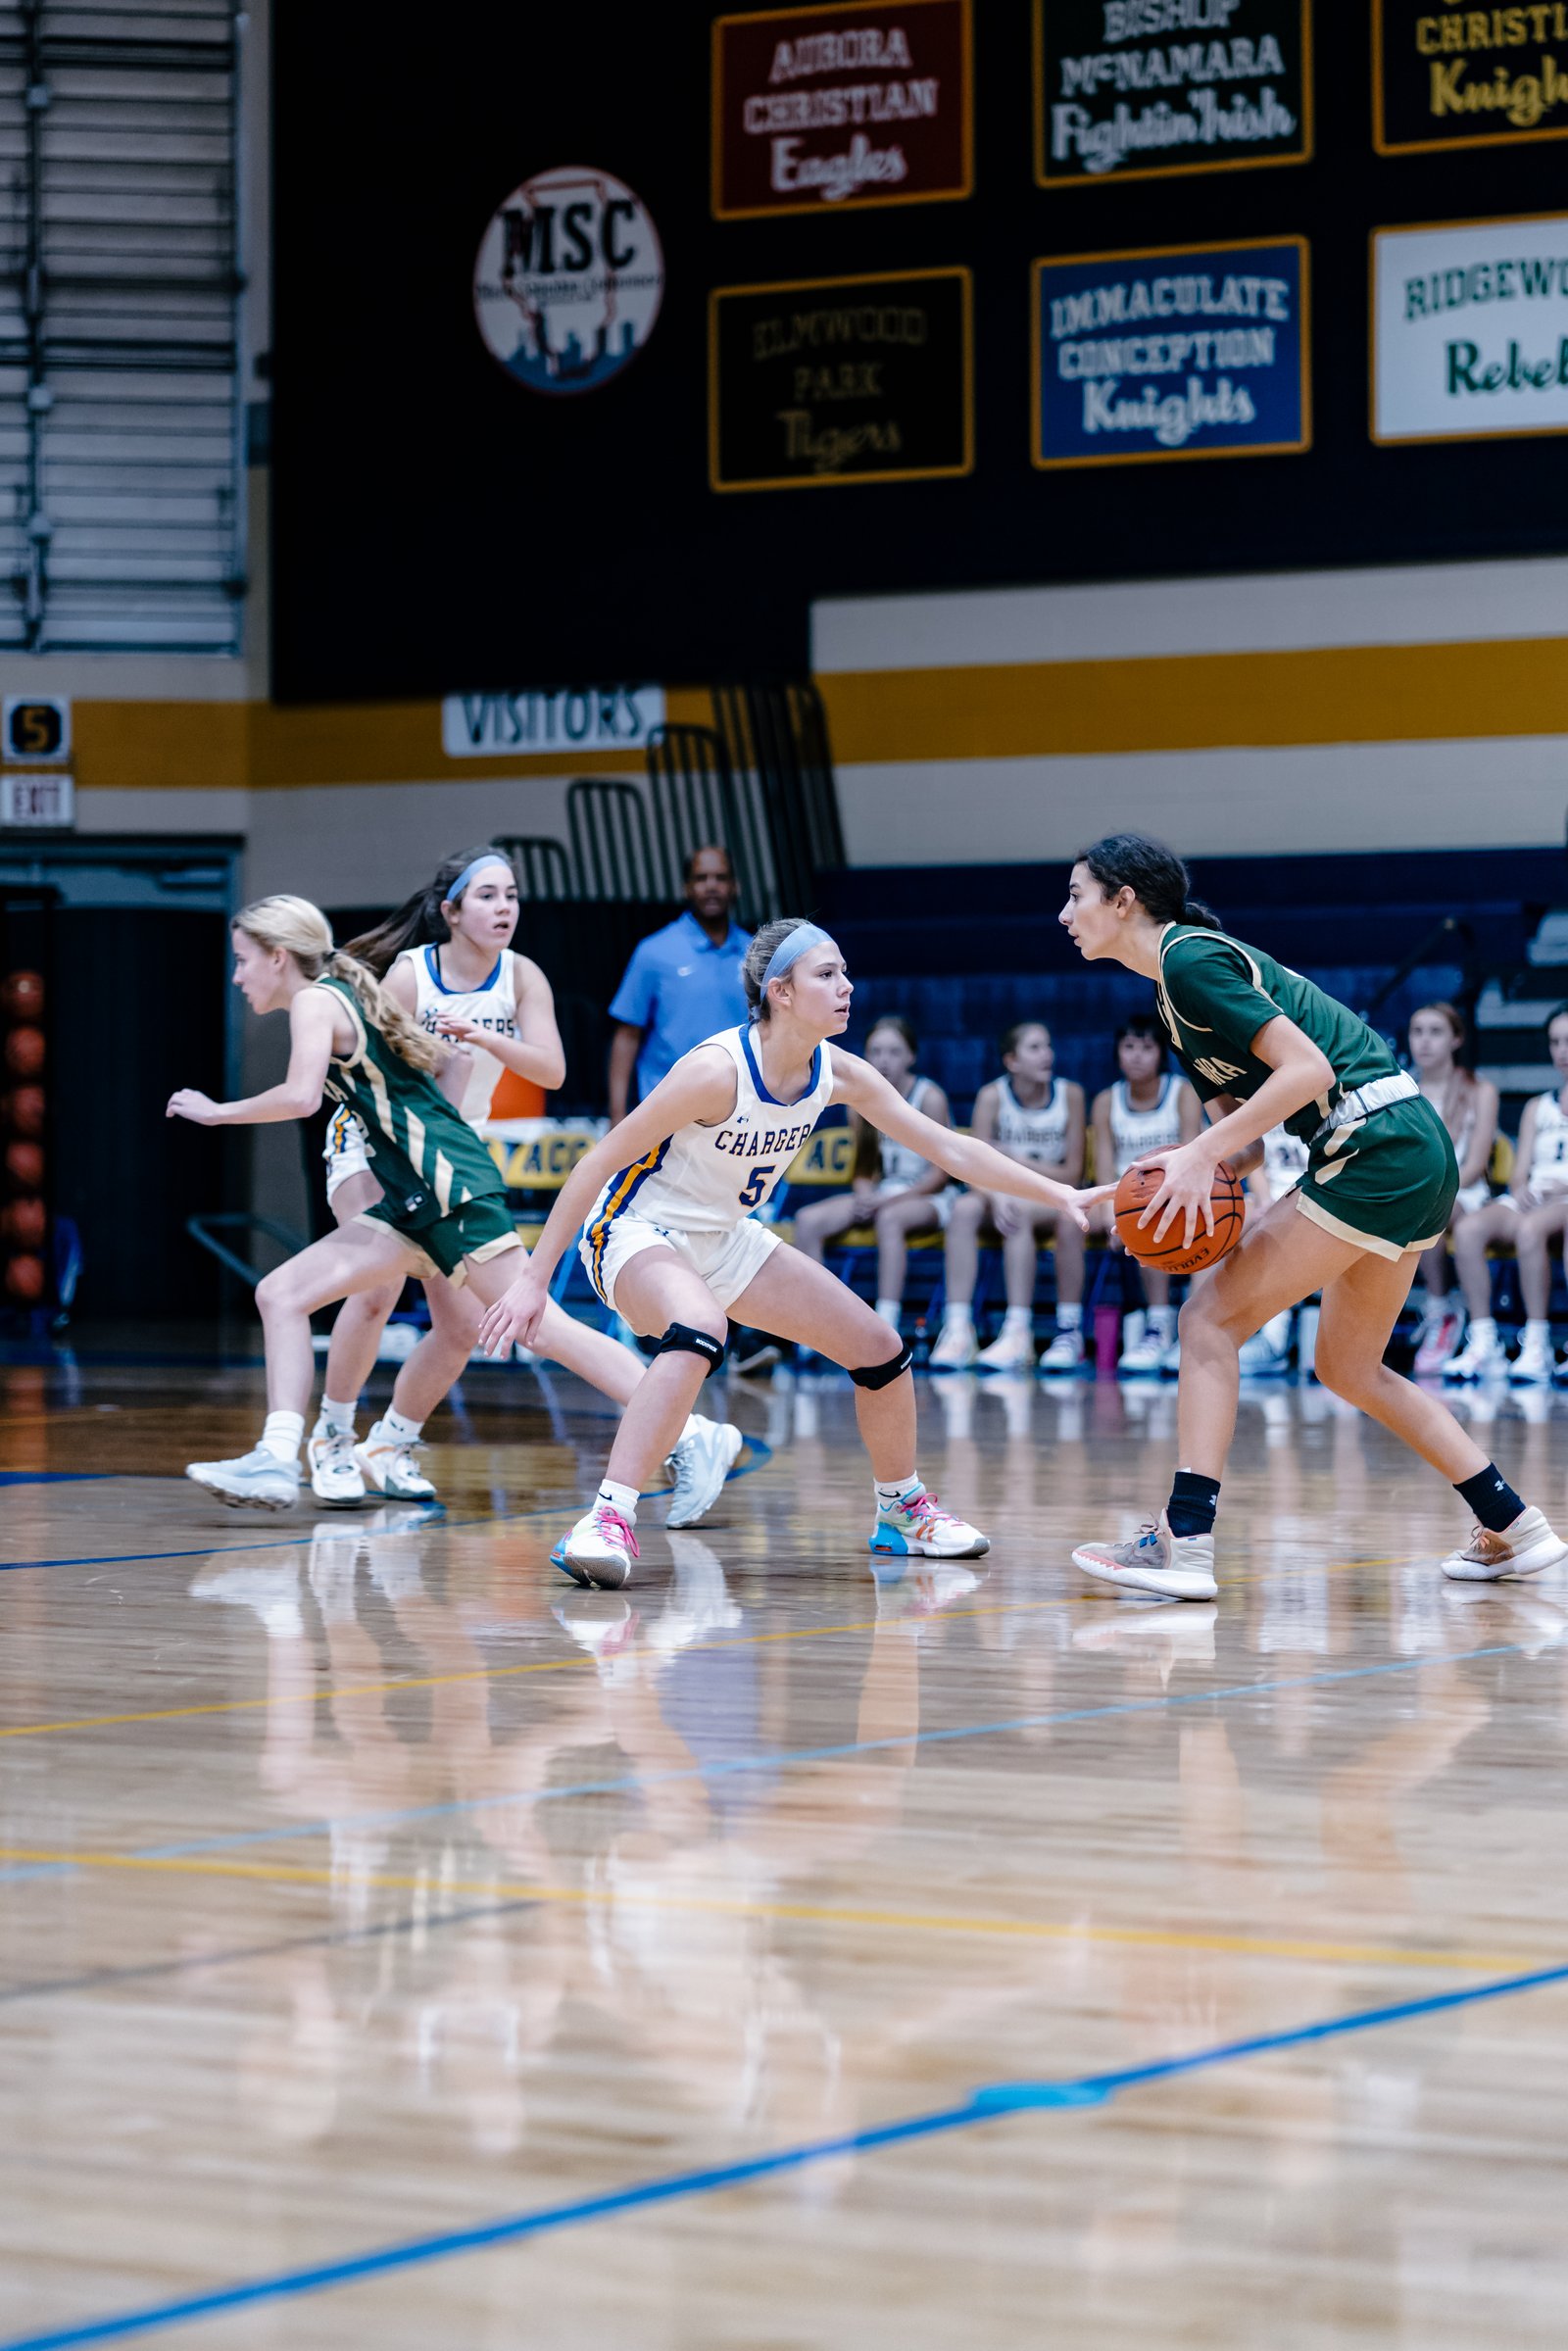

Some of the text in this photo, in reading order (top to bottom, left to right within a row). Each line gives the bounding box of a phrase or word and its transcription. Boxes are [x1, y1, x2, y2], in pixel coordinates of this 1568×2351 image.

[769, 27, 912, 84] AURORA
[1416, 2, 1568, 55] CHRISTI
[743, 77, 938, 134] CHRISTIAN
[1430, 54, 1568, 126] Knigh
[771, 133, 907, 201] Eagles
[500, 199, 635, 278] MSC
[1051, 274, 1290, 339] IMMACULATE
[1058, 326, 1276, 379] CONCEPTION
[1446, 335, 1568, 397] Rebel
[1083, 375, 1256, 446] Knights
[23, 706, 49, 753] 5
[460, 690, 644, 745] VISITORS
[714, 1123, 811, 1156] CHARGER
[739, 1165, 776, 1207] 5
